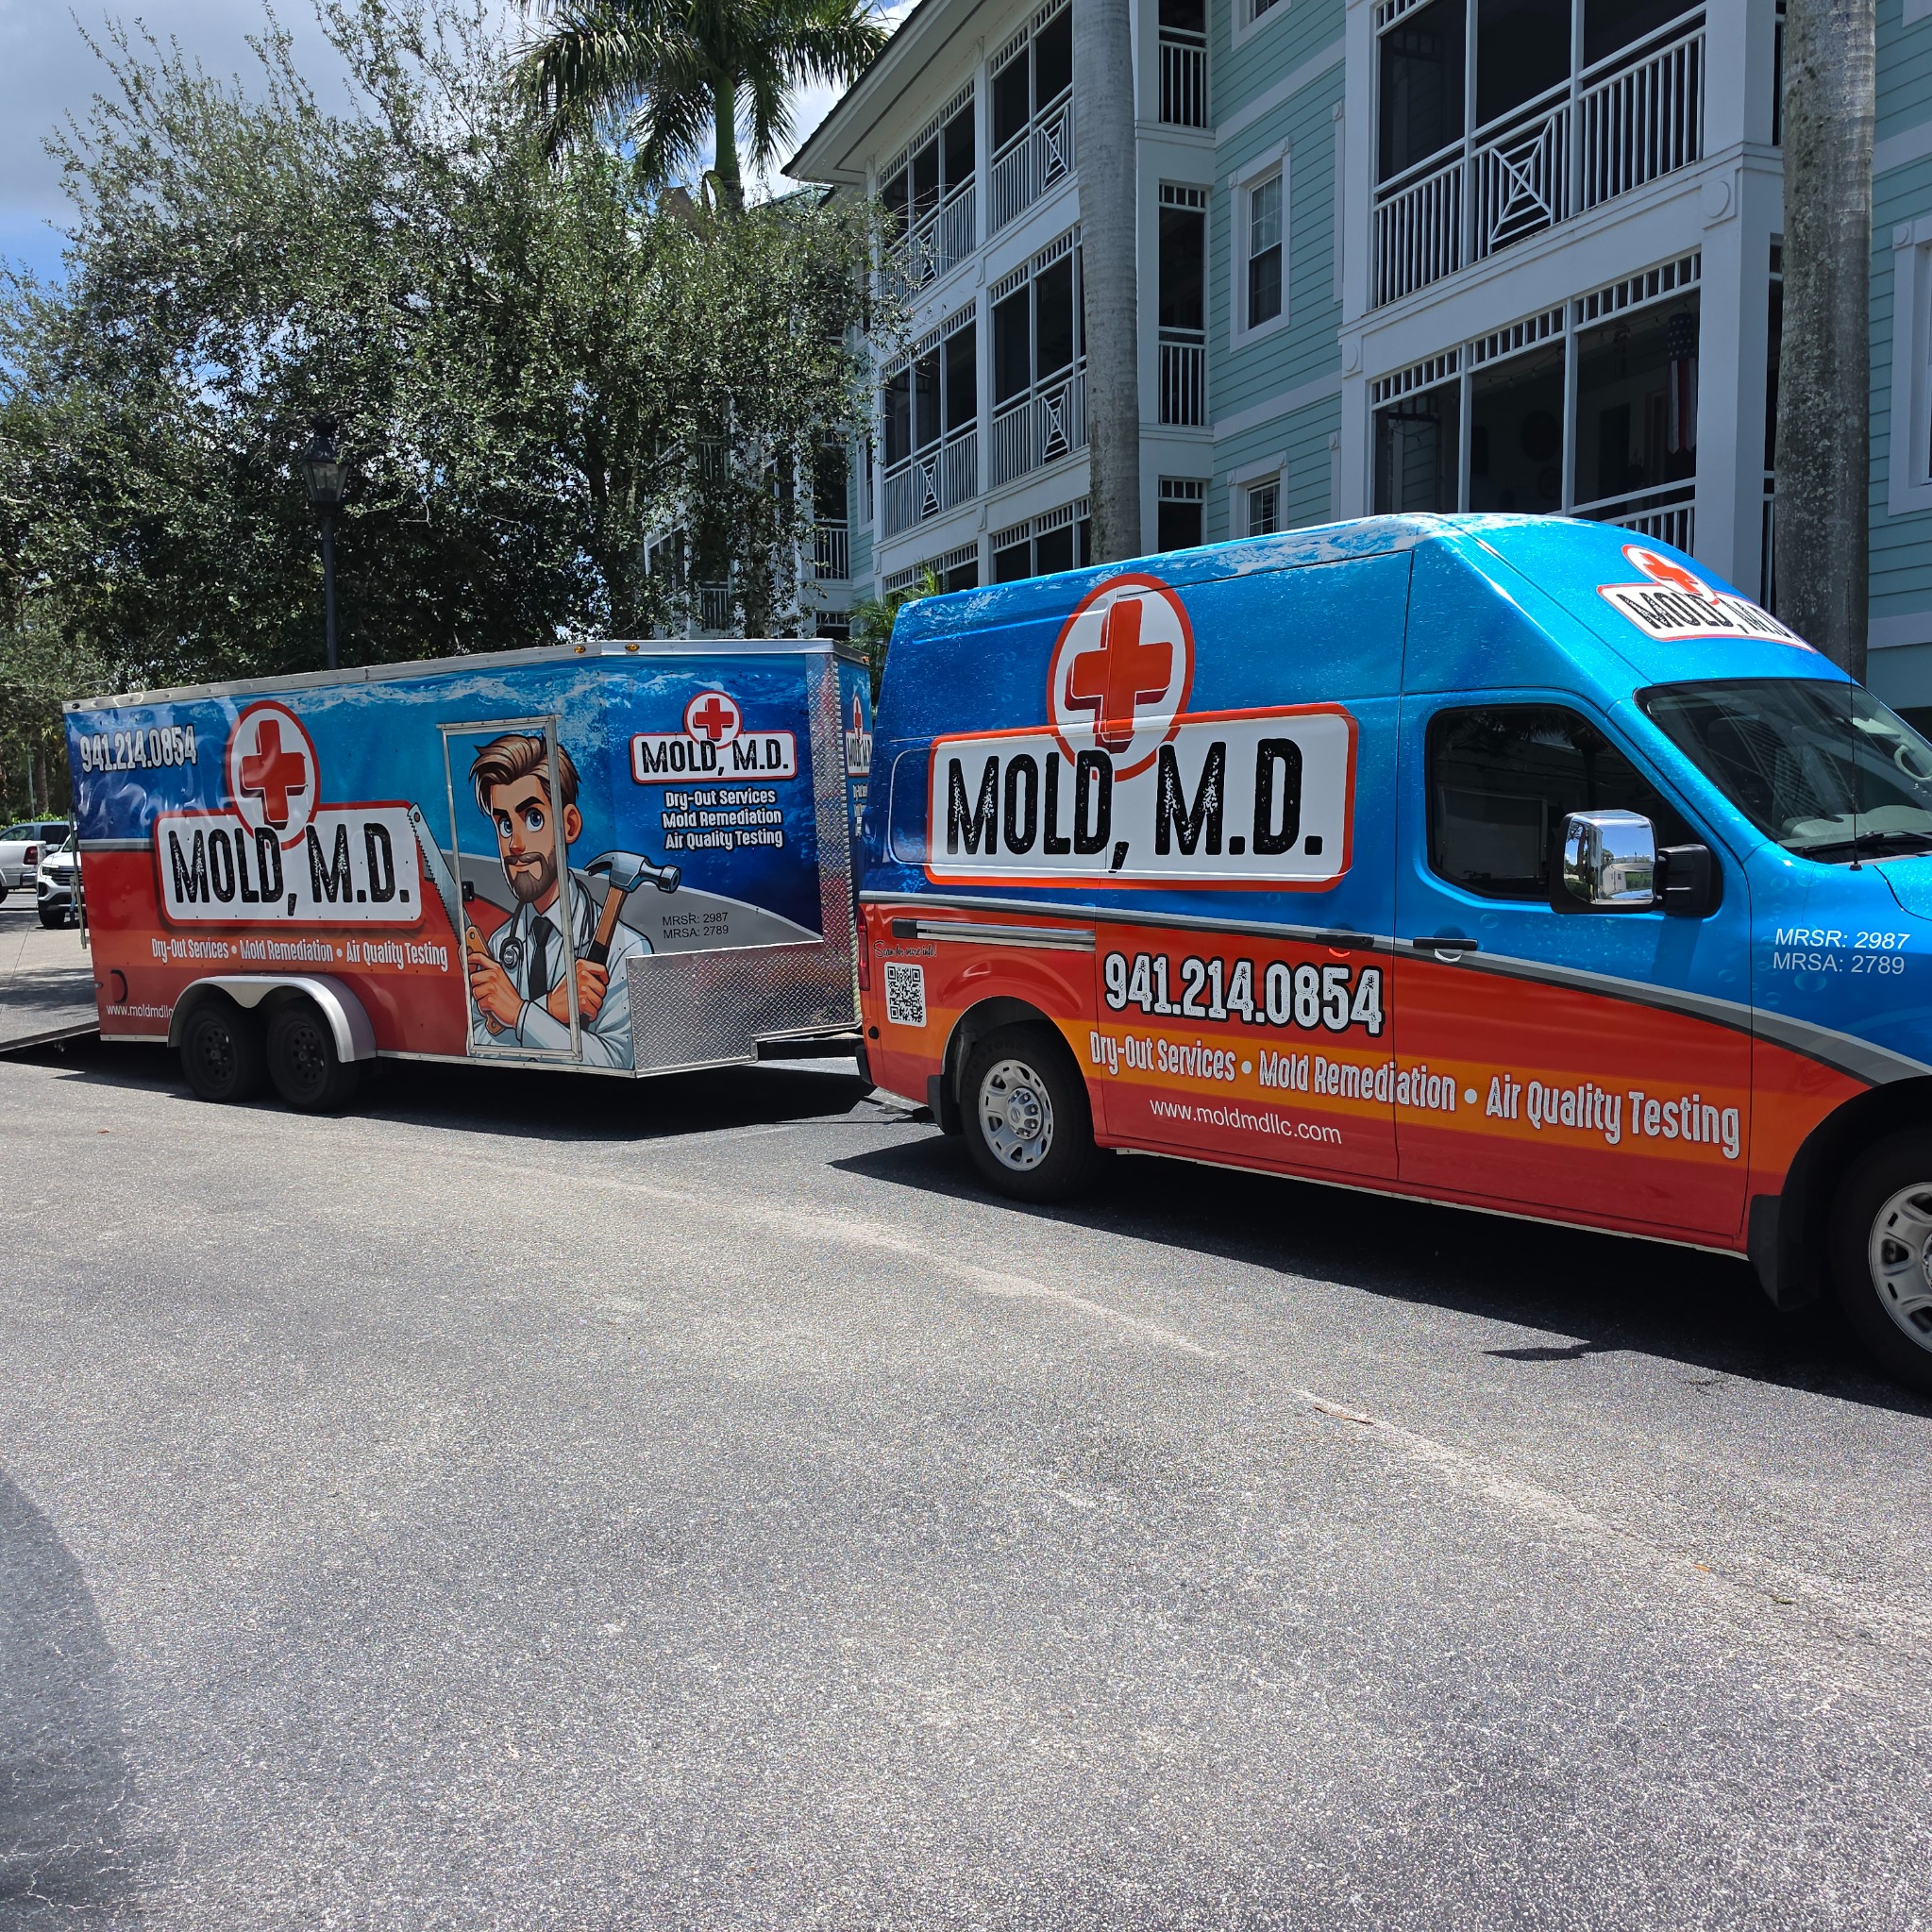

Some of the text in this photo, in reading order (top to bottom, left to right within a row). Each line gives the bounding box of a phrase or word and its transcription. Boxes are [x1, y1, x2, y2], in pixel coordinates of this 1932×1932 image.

[1616, 592, 1749, 634] MOLD,
[79, 725, 197, 773] 941.214.0854
[641, 739, 789, 777] MOLD, M.D.
[664, 787, 776, 811] Dry-Out Services
[948, 737, 1323, 874] MOLD, M.D.
[662, 808, 782, 829] Mold Remediation
[664, 828, 783, 850] Air Quality Testing
[168, 822, 411, 917] MOLD, M.D.
[663, 912, 729, 927] MRSR: 2987
[663, 925, 729, 939] MRSA: 2789
[151, 936, 448, 971] Dry-Out Services Mold Remediation Air Quality Testing
[1774, 928, 1911, 949] MRSR: 2987
[1772, 951, 1905, 975] MRSA: 2789
[1104, 953, 1383, 1034] 941.214.0854
[1089, 1030, 1740, 1160] Dry-Out Services Mold Remediation Air Quality Testing
[1149, 1099, 1342, 1145] www.moldmdllc.com
